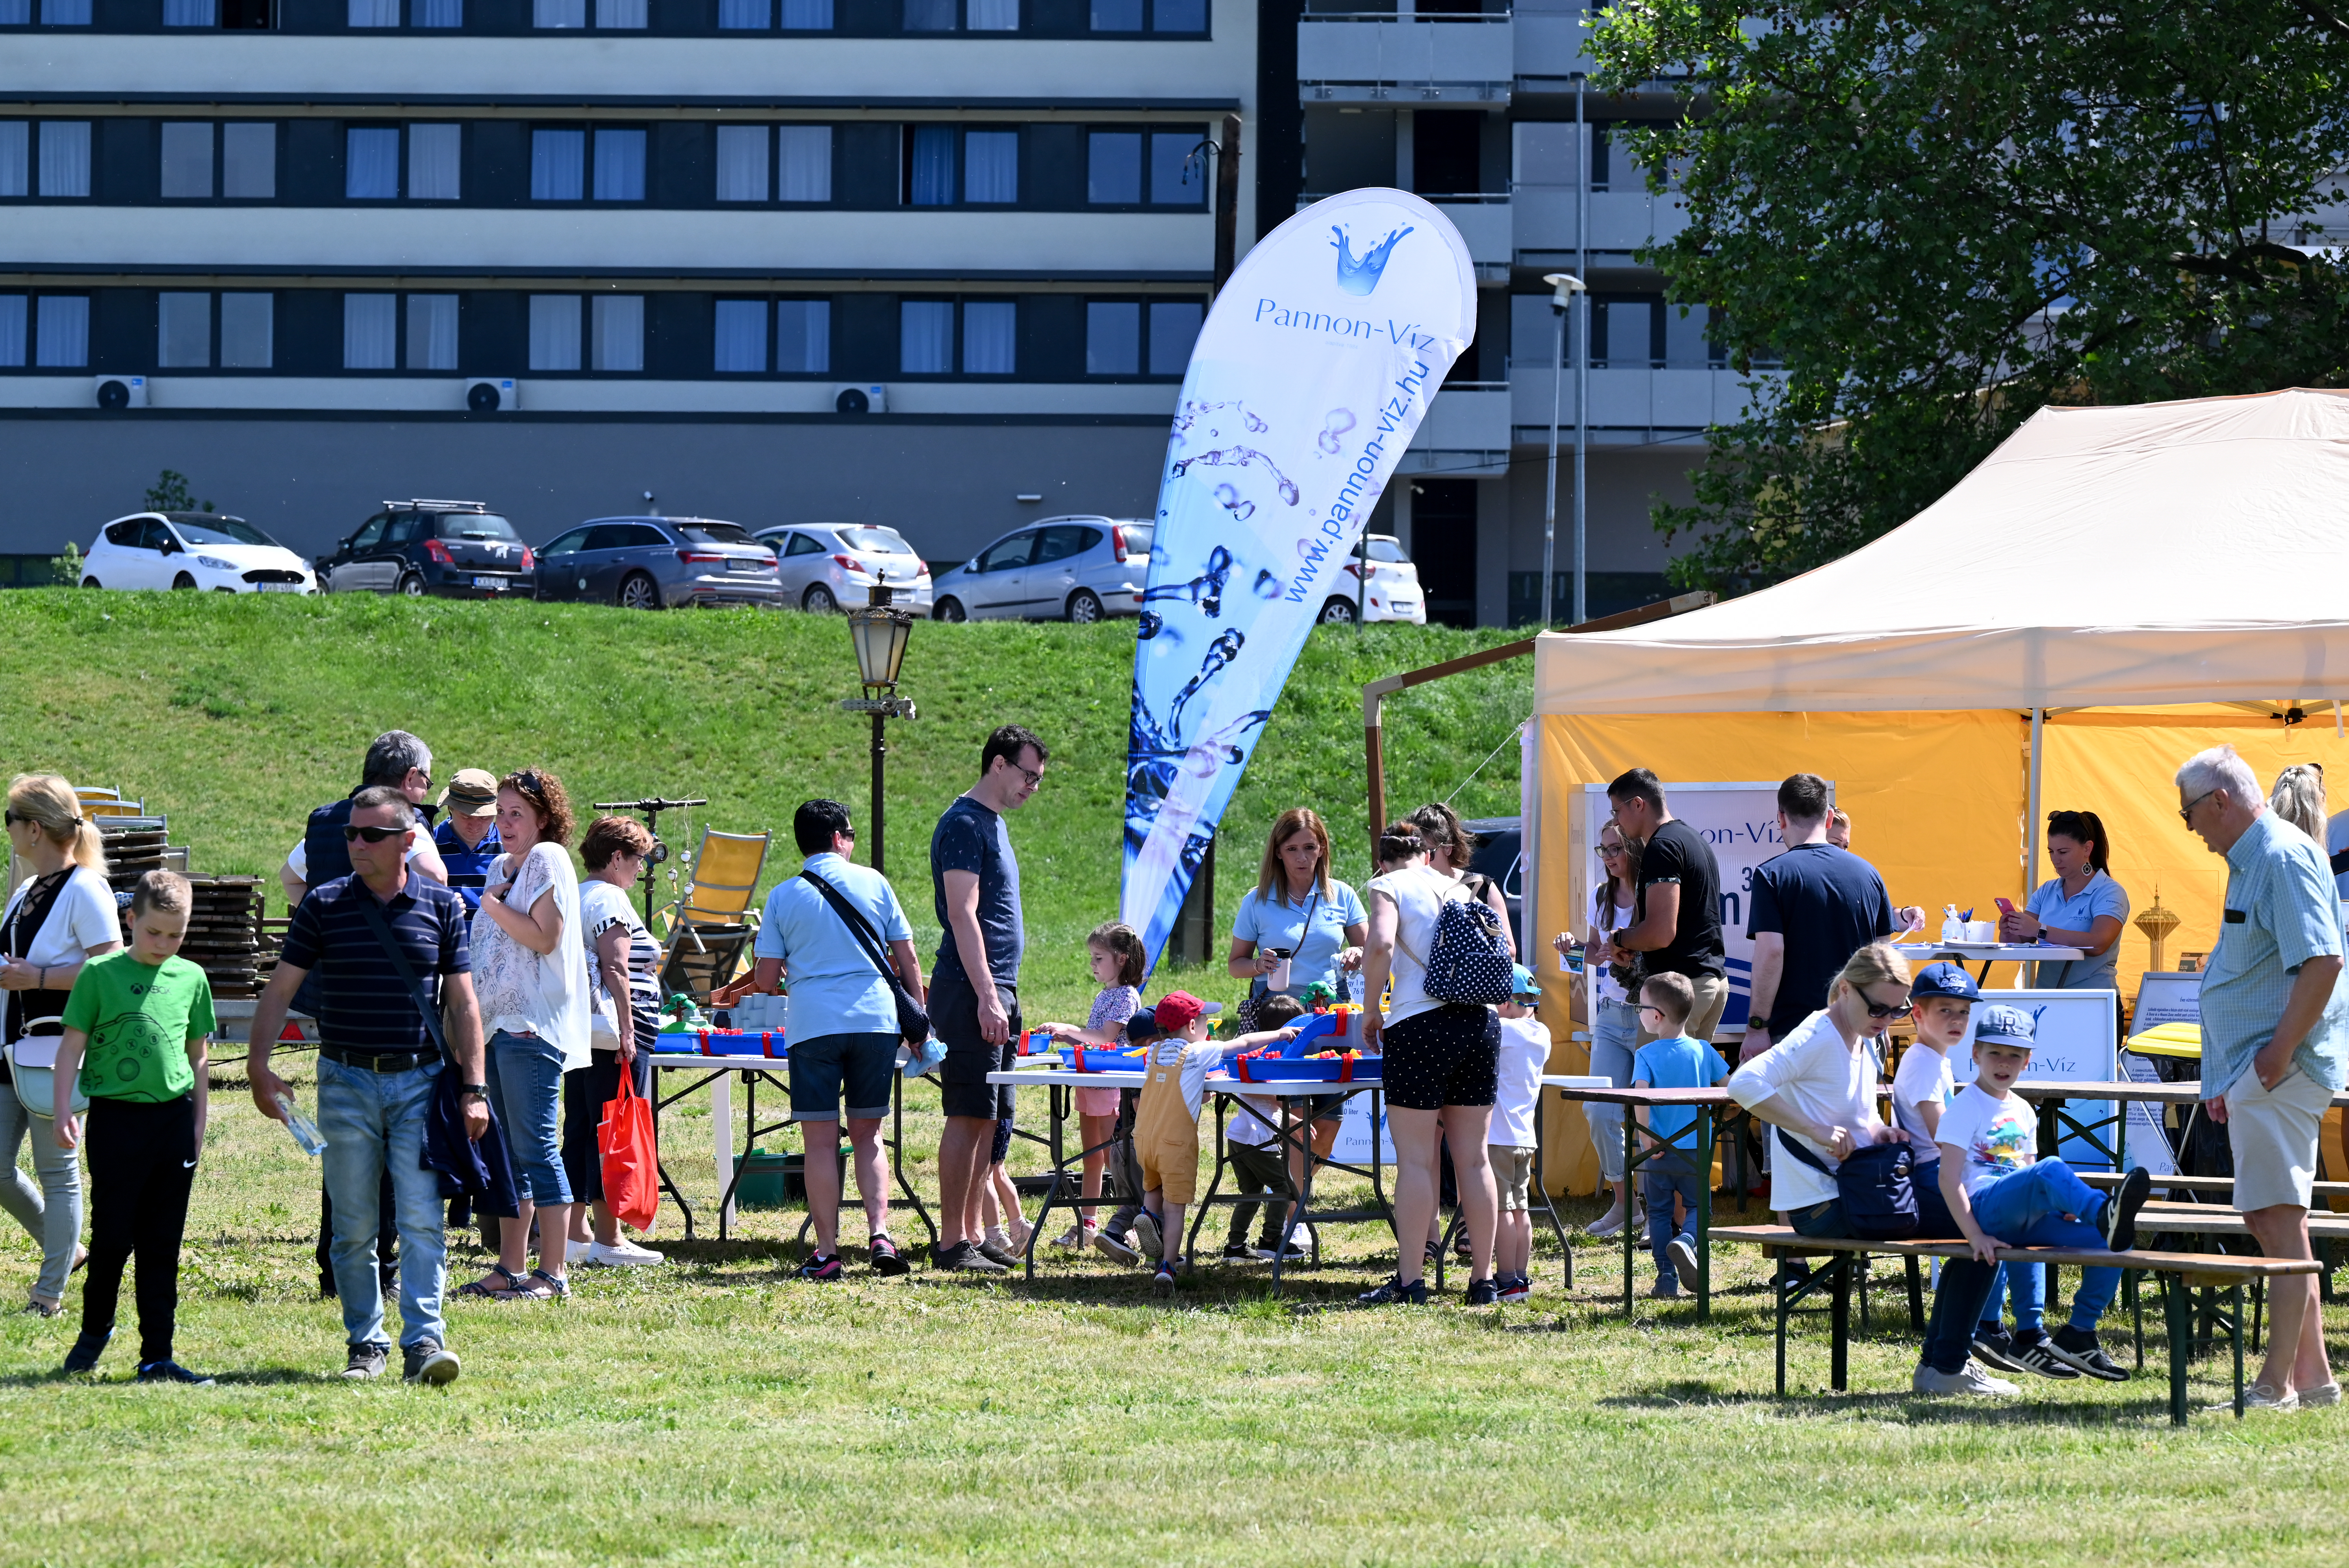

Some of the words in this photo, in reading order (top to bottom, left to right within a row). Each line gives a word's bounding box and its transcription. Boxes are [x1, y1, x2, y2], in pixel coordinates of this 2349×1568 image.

[1255, 298, 1435, 354] Pannon-Víz
[1285, 360, 1430, 603] www.pannon-viz.hu
[1700, 820, 1785, 844] on-Víz
[146, 985, 172, 995] XBOX
[2000, 1016, 2017, 1034] R
[1969, 1057, 2076, 1072] Pn-Víz
